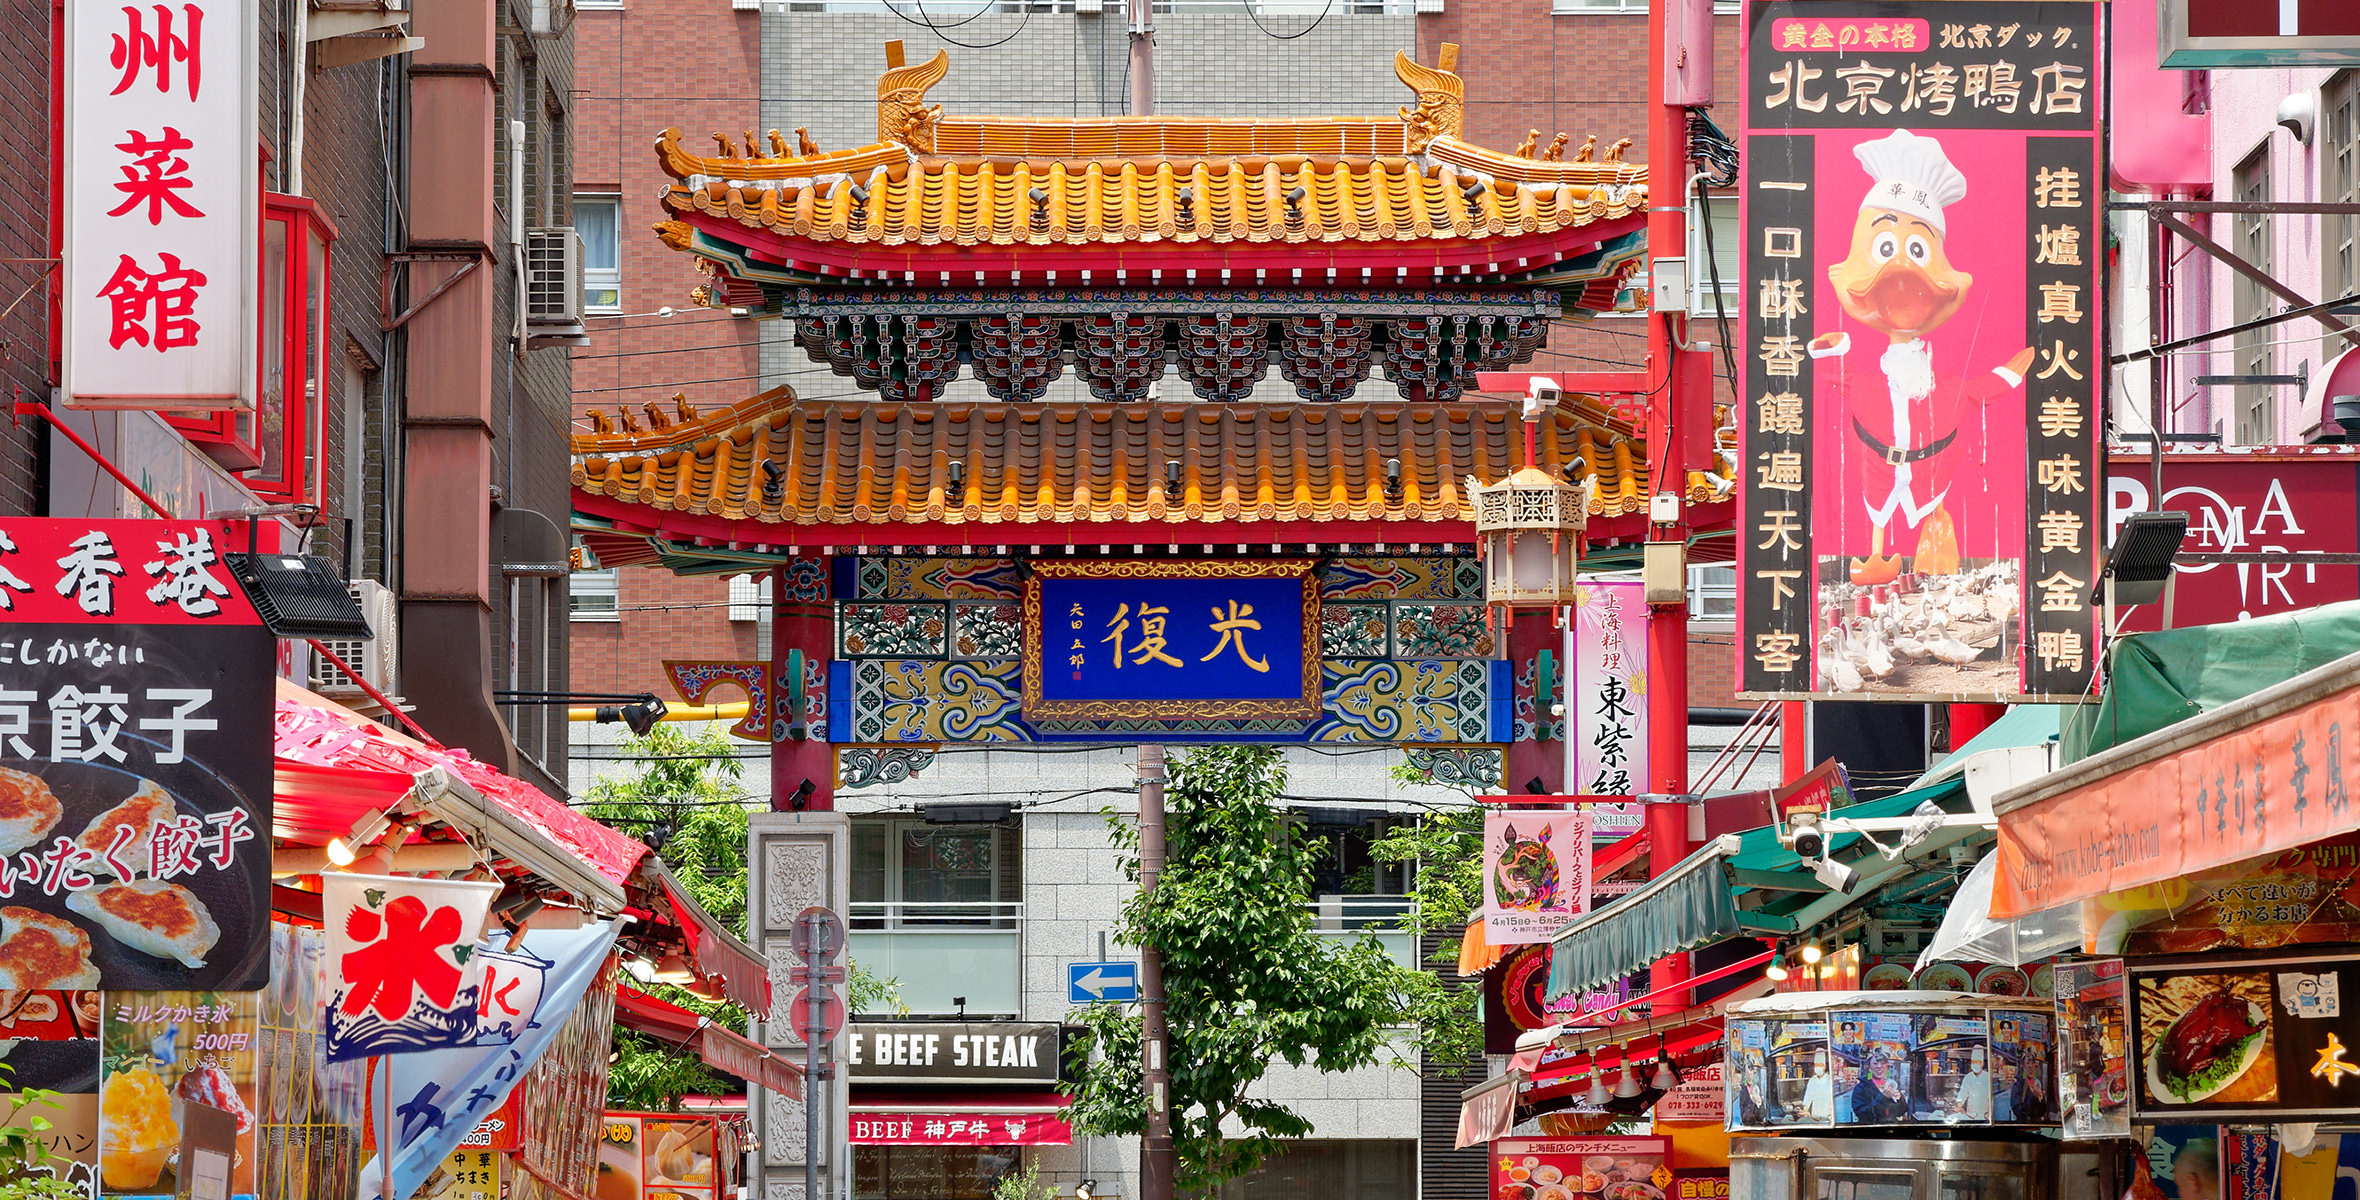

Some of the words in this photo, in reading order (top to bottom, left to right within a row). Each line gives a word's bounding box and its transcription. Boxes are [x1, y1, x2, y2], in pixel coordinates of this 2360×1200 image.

[1782, 22, 1917, 49] 黄金の本格
[1939, 22, 2074, 50] 北京ダック
[1765, 59, 2086, 116] 北京烤鴨店
[96, 3, 208, 353] 州菜館
[1601, 593, 1622, 670] 上海料理
[1592, 814, 1642, 827] OSHIEN
[340, 895, 464, 1022] 氷
[115, 1004, 232, 1024] ミルクかき氷
[192, 1032, 250, 1052] 500円
[874, 1034, 940, 1066] BEEF
[953, 1035, 1038, 1067] STEAK
[103, 1053, 165, 1070] マンゴー
[184, 1053, 236, 1073] いちご
[2310, 1032, 2360, 1087] 本
[856, 1121, 913, 1139] BEEF
[924, 1119, 991, 1140] 神戸牛
[1525, 1143, 1637, 1154] 上海飯店のランチメニュー
[455, 1171, 490, 1185] ちまき
[1680, 1179, 1730, 1199] 自慢の
